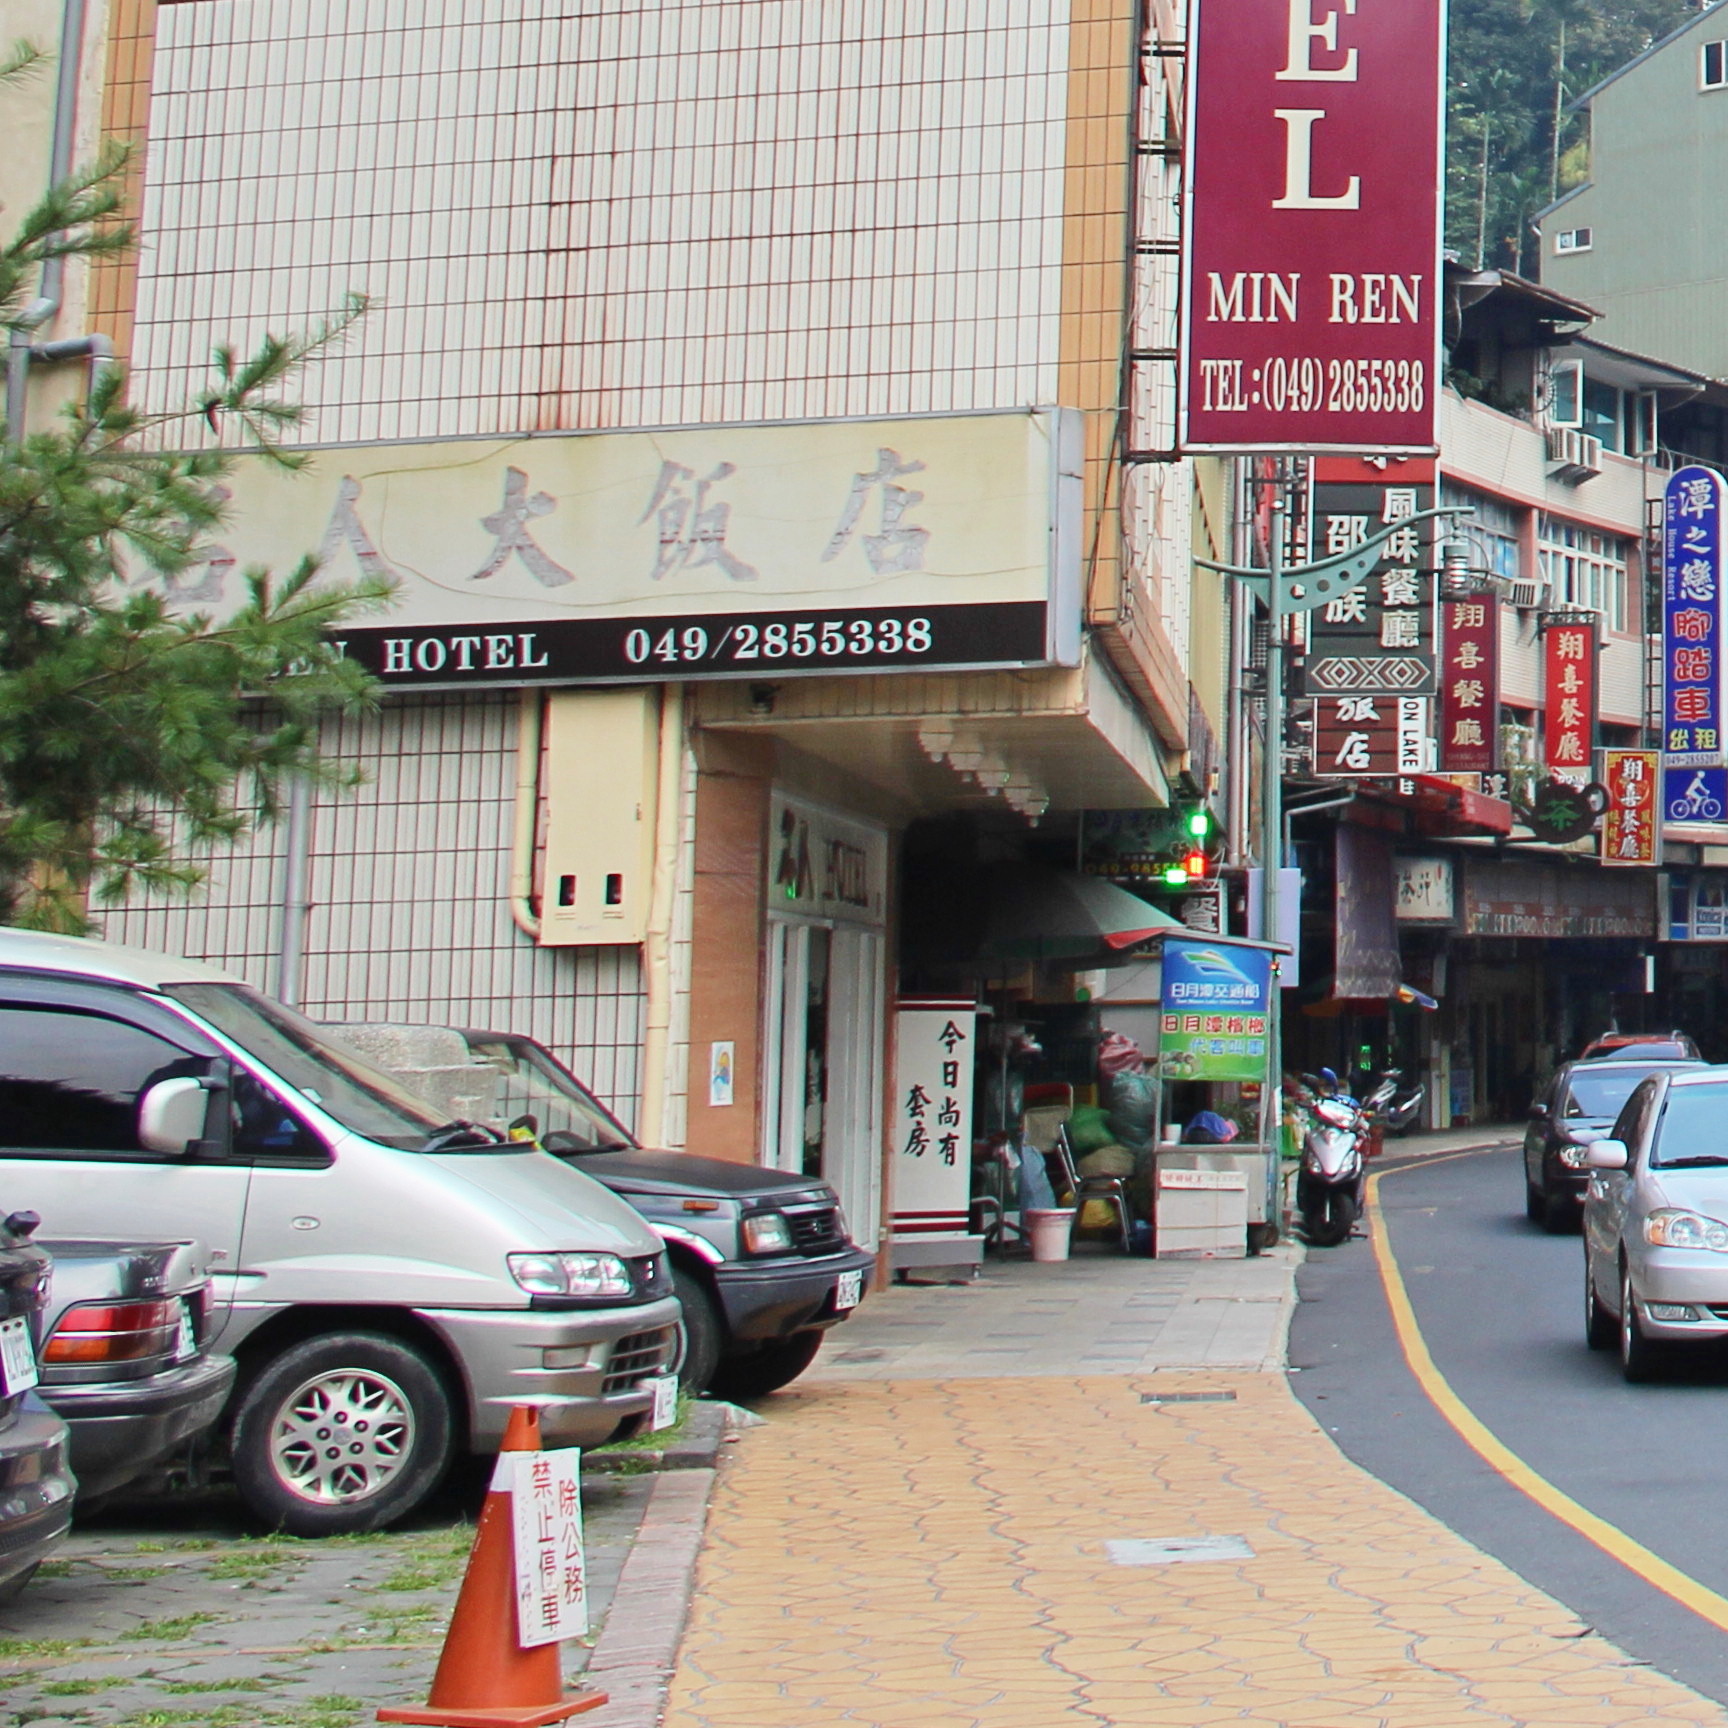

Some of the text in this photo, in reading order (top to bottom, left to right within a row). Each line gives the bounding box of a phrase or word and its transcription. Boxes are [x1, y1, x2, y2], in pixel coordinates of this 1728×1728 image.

[1206, 271, 1421, 324] MIN REN
[1326, 514, 1369, 623] 邵族
[1381, 487, 1420, 650] 風味餐廳
[1680, 477, 1716, 602] 潭之戀
[383, 633, 549, 673] HOTEL
[624, 617, 933, 664] 049/2855338
[1452, 602, 1486, 747] 翔喜餐廳
[1556, 630, 1584, 762] 翔喜餐廳
[1673, 608, 1713, 722] 腳踏車
[1402, 729, 1420, 768] LAKE
[1669, 727, 1718, 751] 出租
[1539, 799, 1581, 831] 茶
[1618, 758, 1645, 859] 翔喜餐廳
[1171, 982, 1260, 999] 日月潭交通船
[903, 1084, 932, 1158] 套房
[937, 1019, 966, 1167] 今日尚有
[532, 1460, 562, 1632] 禁止停車
[559, 1478, 584, 1606] 除公務
